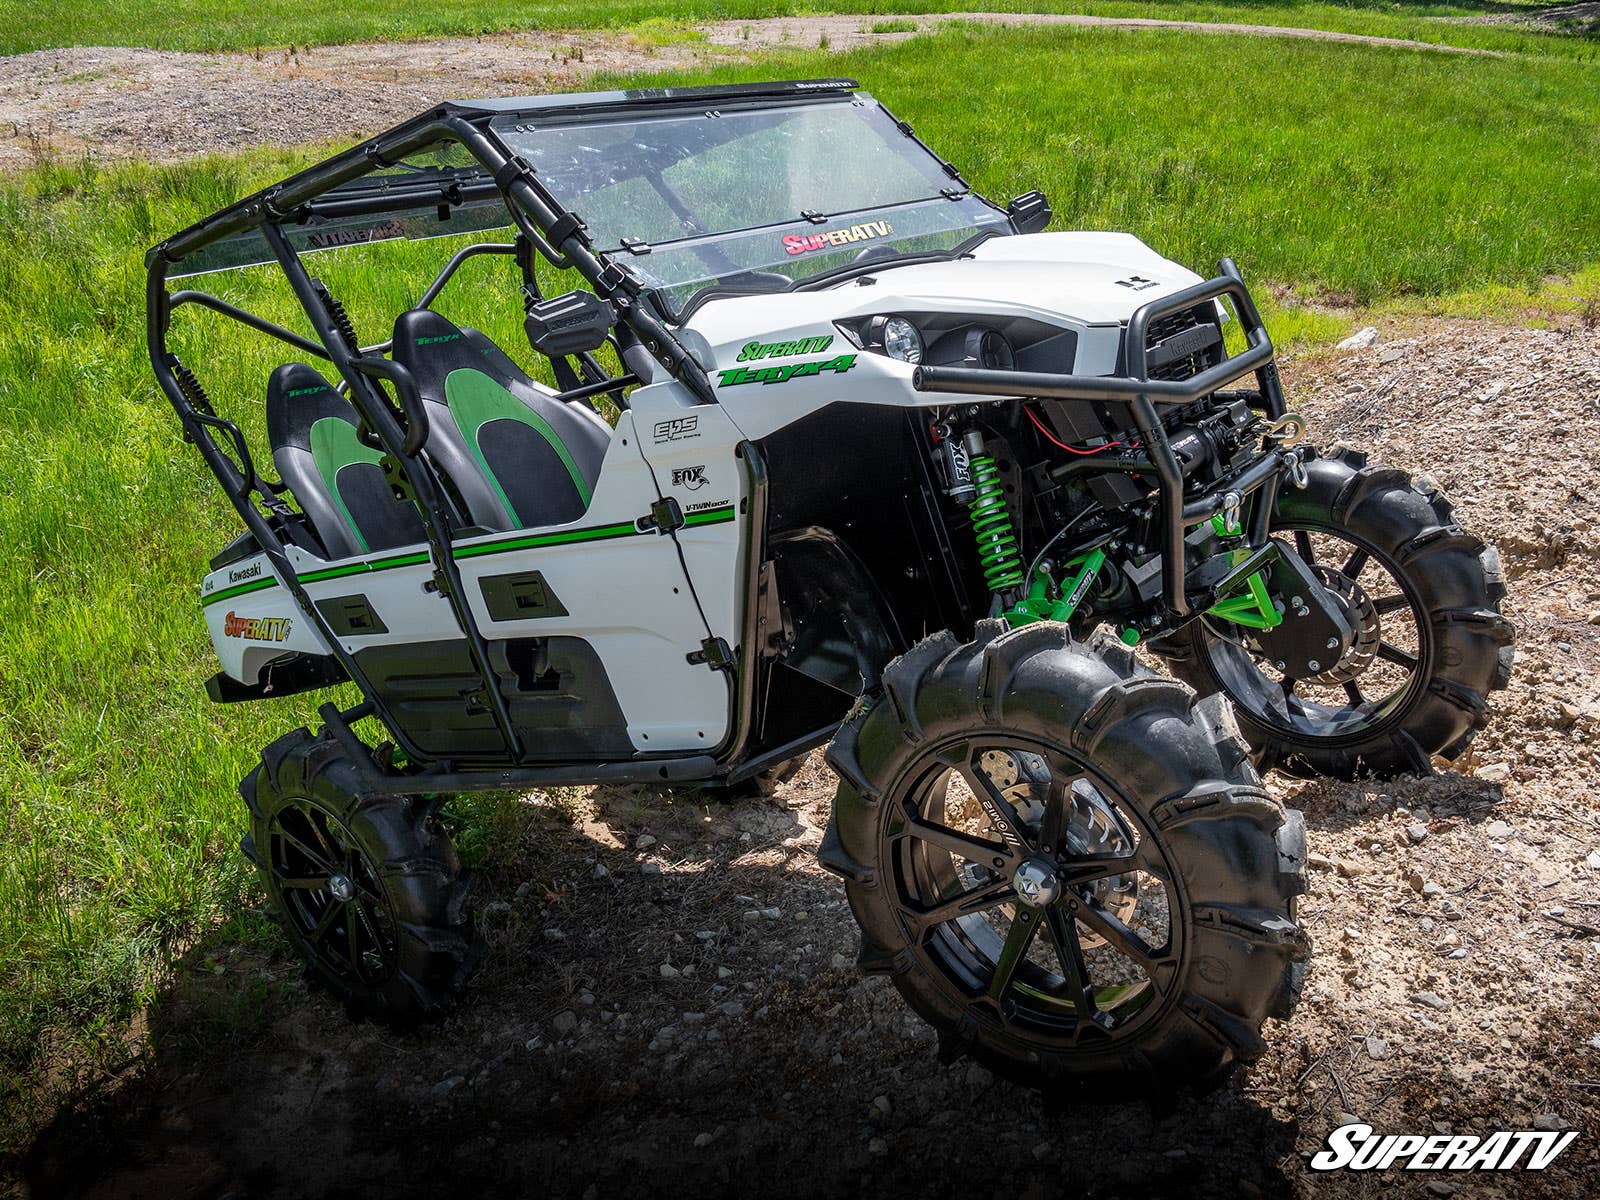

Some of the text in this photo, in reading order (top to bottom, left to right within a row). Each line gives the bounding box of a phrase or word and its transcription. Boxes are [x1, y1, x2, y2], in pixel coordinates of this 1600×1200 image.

[782, 221, 889, 255] SUPERATV
[736, 335, 834, 362] SUPERATV
[717, 354, 858, 388] TERYX4
[653, 415, 699, 439] EPS
[950, 440, 970, 481] FOX
[672, 465, 708, 488] FOX
[229, 562, 262, 584] Kawasaki
[224, 611, 291, 641] SUPERATV
